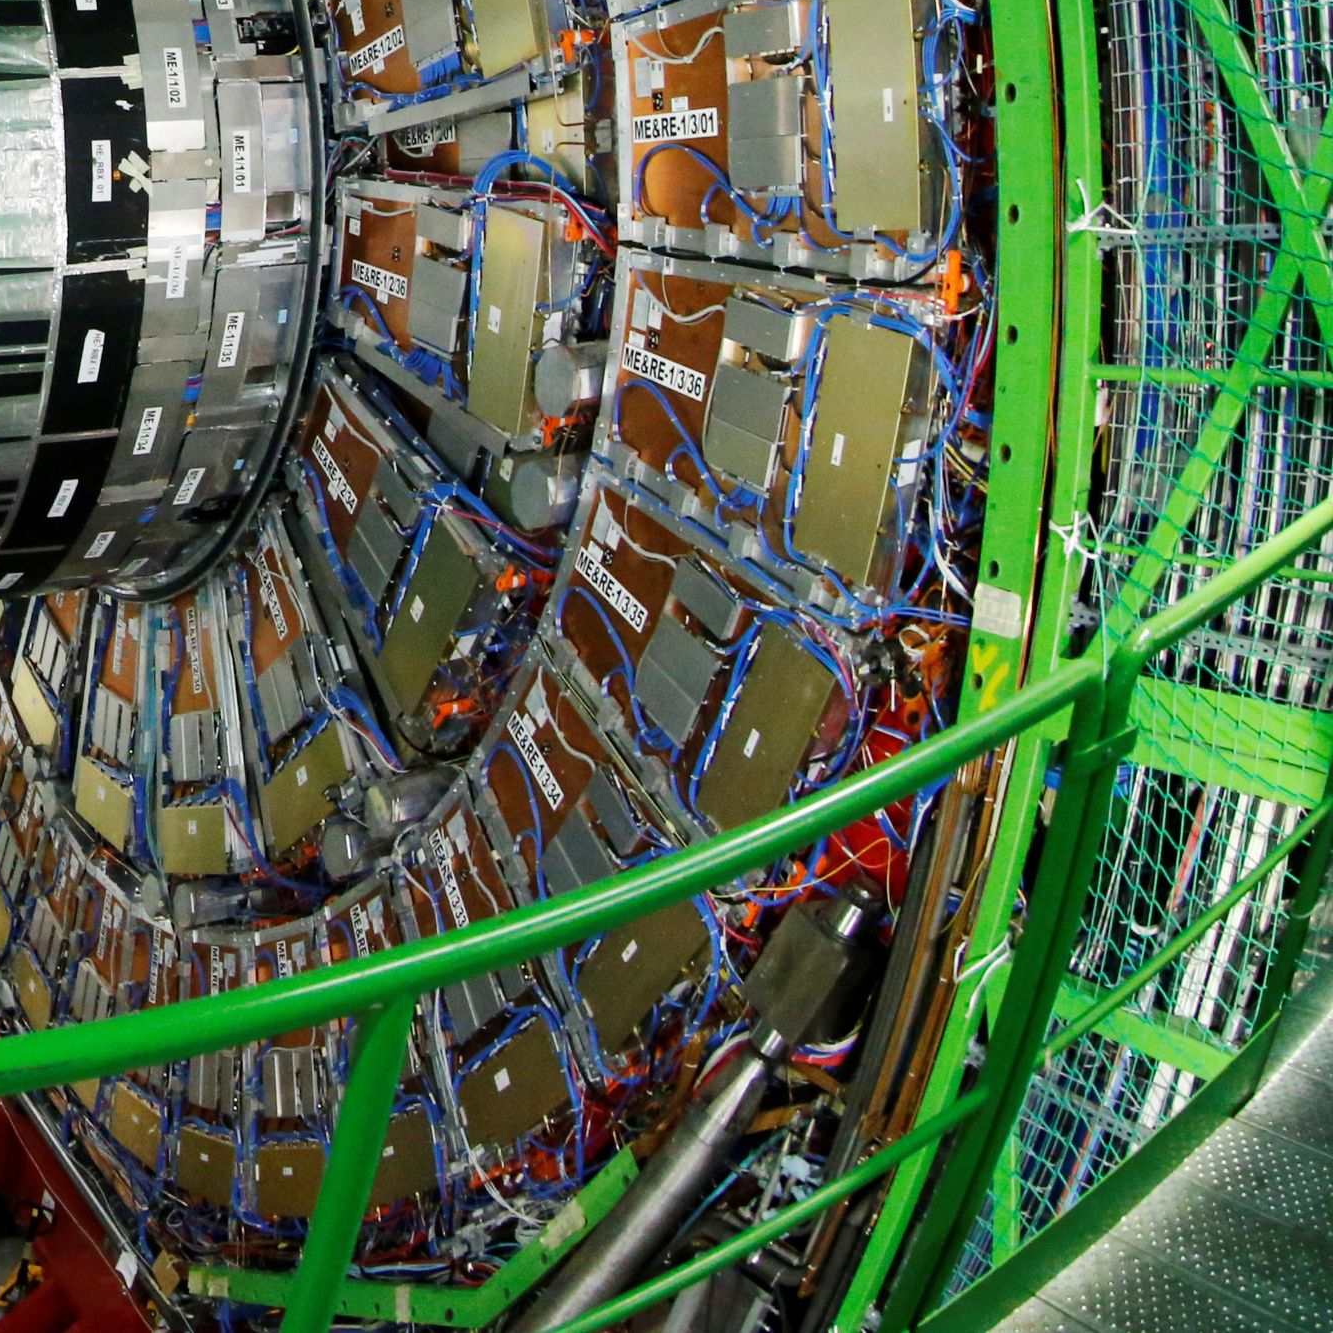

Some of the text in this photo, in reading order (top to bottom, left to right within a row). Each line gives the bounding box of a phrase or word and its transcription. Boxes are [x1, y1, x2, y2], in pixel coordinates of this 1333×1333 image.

[351, 28, 403, 71] ME&RE-1/2/02
[166, 51, 181, 104] ME-1/1/02
[634, 112, 715, 142] ME&RE-1/3/01
[234, 134, 245, 188] ME-1/1/01
[353, 262, 406, 296] ME&RE-1/2/36
[221, 314, 238, 363] ME-1/1/35
[624, 347, 702, 397] ME&RE-1/3/36
[135, 410, 156, 451] ME-1/1/34
[314, 438, 356, 512] ME&RE-1/2/34
[578, 551, 645, 630] ME&RE-1/3/35
[511, 714, 561, 806] ME&RE-1/3/34
